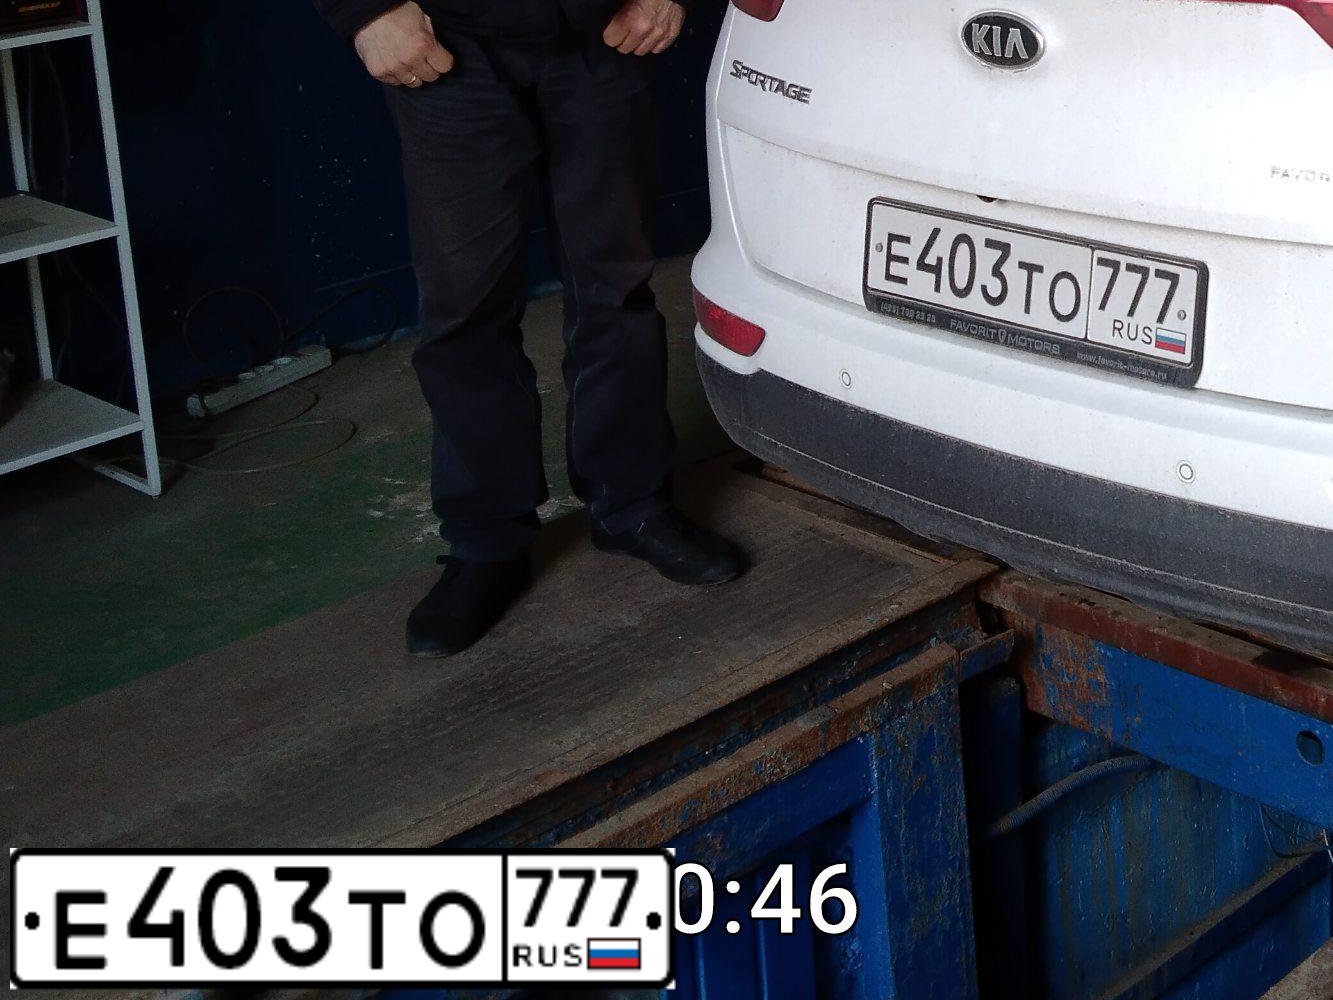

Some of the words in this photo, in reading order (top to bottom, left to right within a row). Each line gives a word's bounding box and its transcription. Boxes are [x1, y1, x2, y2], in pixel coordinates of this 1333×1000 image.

[970, 21, 1029, 61] KIA
[729, 59, 813, 104] SPORTAGE
[1096, 256, 1181, 325] 777
[949, 318, 997, 340] FAVORIT
[1006, 333, 1061, 355] MOTORS
[1111, 318, 1154, 346] RUS
